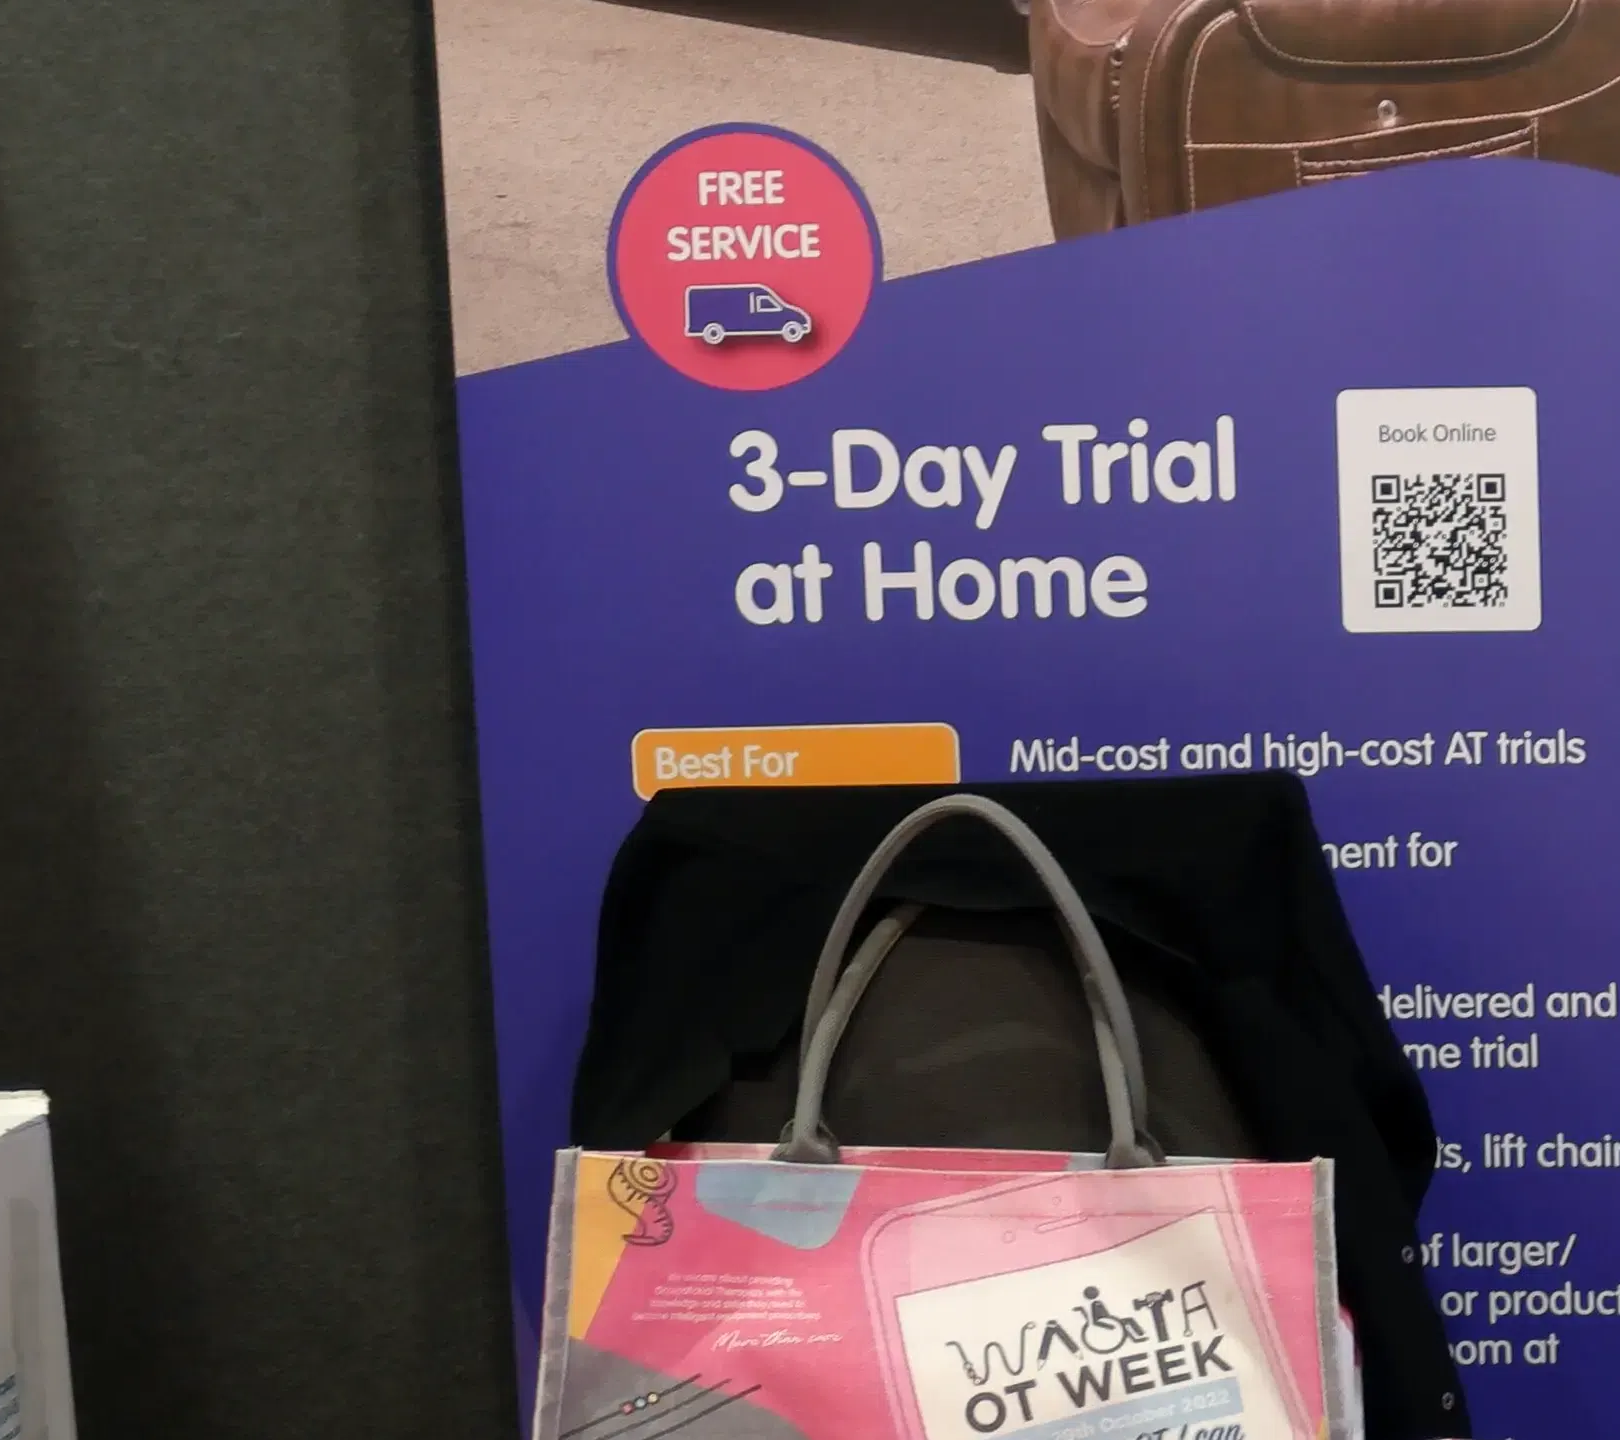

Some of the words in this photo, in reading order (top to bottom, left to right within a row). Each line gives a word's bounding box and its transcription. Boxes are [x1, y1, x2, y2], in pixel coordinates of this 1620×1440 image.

[697, 169, 785, 208] FREE
[666, 223, 821, 263] SERVICE
[1376, 420, 1430, 444] Book
[1435, 420, 1497, 444] Online
[726, 425, 1018, 530] 3-Day
[1041, 413, 1238, 506] Trial
[733, 543, 833, 626] at
[864, 539, 1150, 623] Home
[654, 745, 733, 780] Best
[742, 744, 800, 779] For
[1010, 737, 1171, 773] Mid-cost
[1180, 734, 1253, 772] and
[1262, 728, 1435, 777] high-cost
[1444, 729, 1486, 766] AT
[1495, 727, 1587, 766] trials
[1406, 831, 1460, 868] for
[1545, 981, 1619, 1019] and
[1469, 1032, 1540, 1070] trial
[1483, 1132, 1527, 1169] lift
[1452, 1232, 1578, 1275] larger/
[1439, 1289, 1480, 1317] or
[1522, 1332, 1561, 1365] at
[964, 1379, 1038, 1434] OT
[1055, 1333, 1235, 1410] WEEK
[1099, 1400, 1177, 1436] October
[1181, 1387, 1232, 1413] 2022
